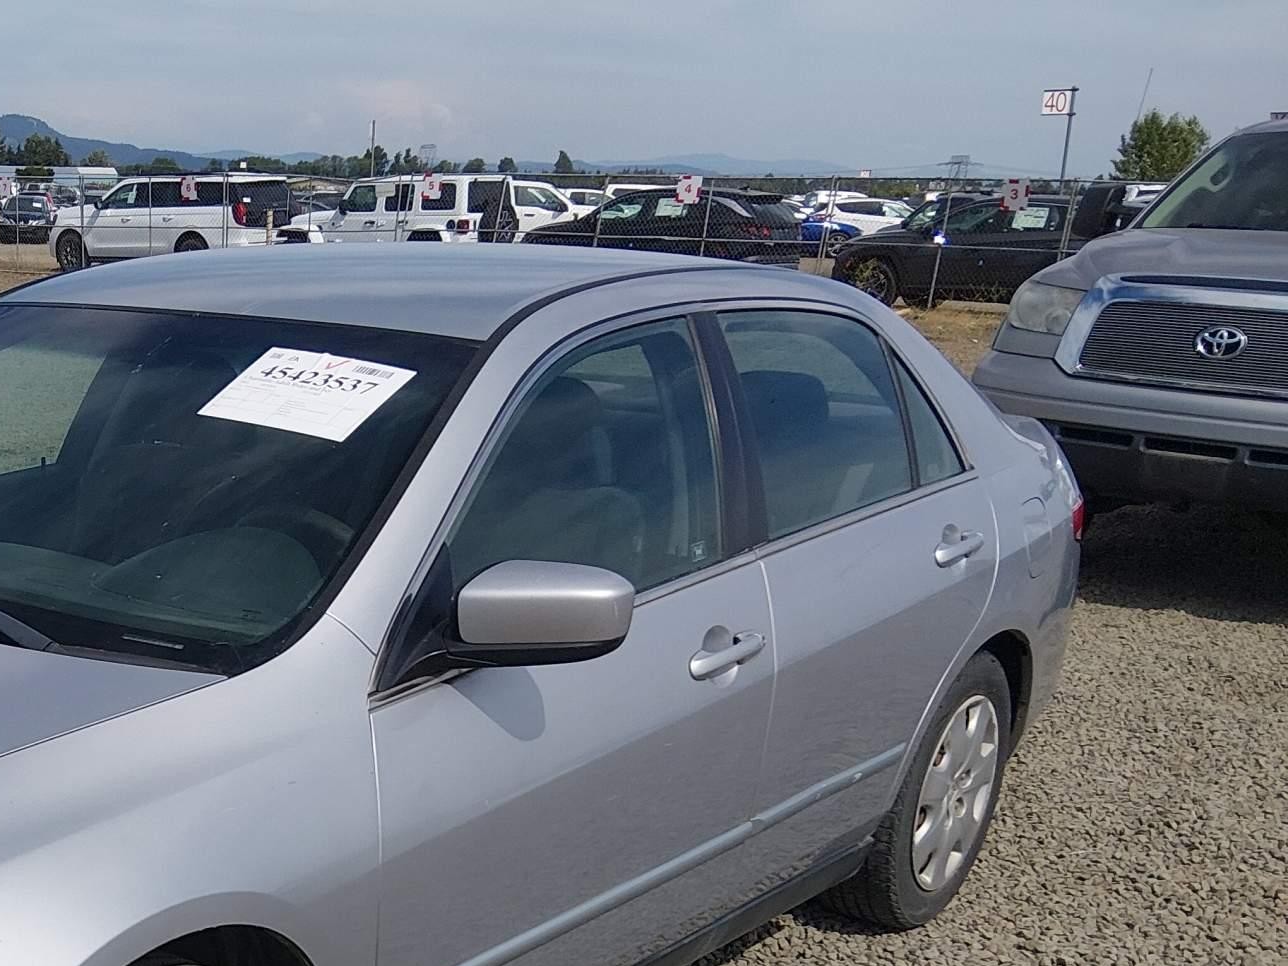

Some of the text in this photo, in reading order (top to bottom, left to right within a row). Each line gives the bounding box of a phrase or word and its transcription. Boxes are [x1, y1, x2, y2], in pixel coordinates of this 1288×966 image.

[1043, 91, 1067, 113] 40
[185, 183, 192, 193] 6
[428, 181, 435, 190] 5
[684, 183, 692, 194] 4
[1010, 188, 1018, 200] 3
[260, 364, 380, 395] 45423537
